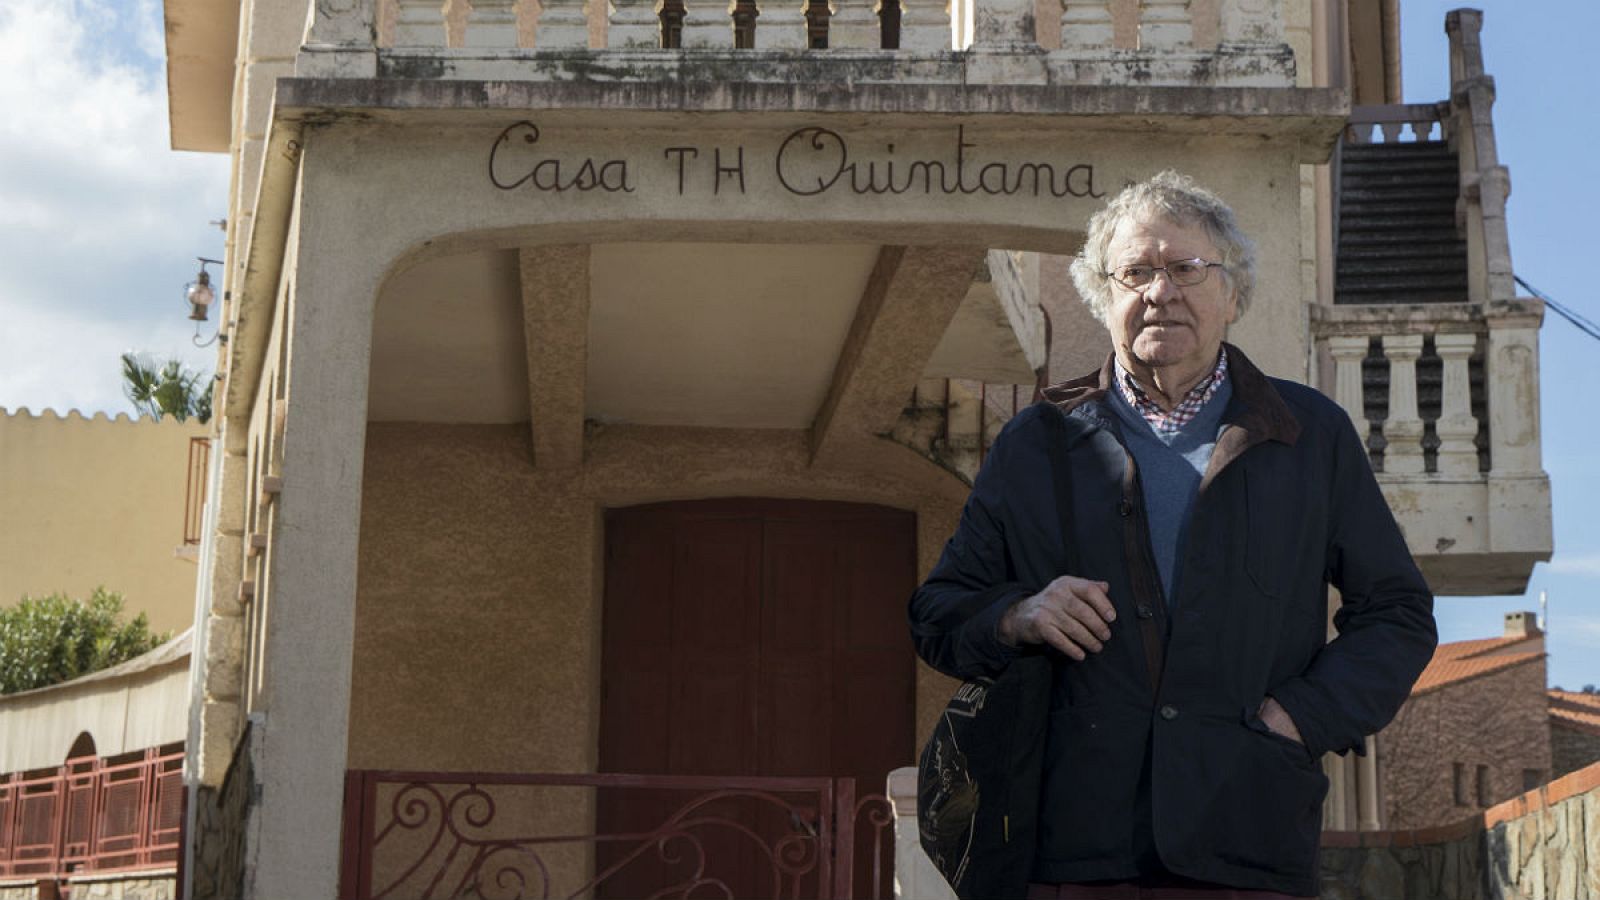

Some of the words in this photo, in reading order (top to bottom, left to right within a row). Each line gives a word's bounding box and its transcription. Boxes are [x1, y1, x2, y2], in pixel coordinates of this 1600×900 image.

[488, 120, 635, 193] Casa
[664, 146, 746, 196] TH
[776, 122, 1107, 199] Quintana
